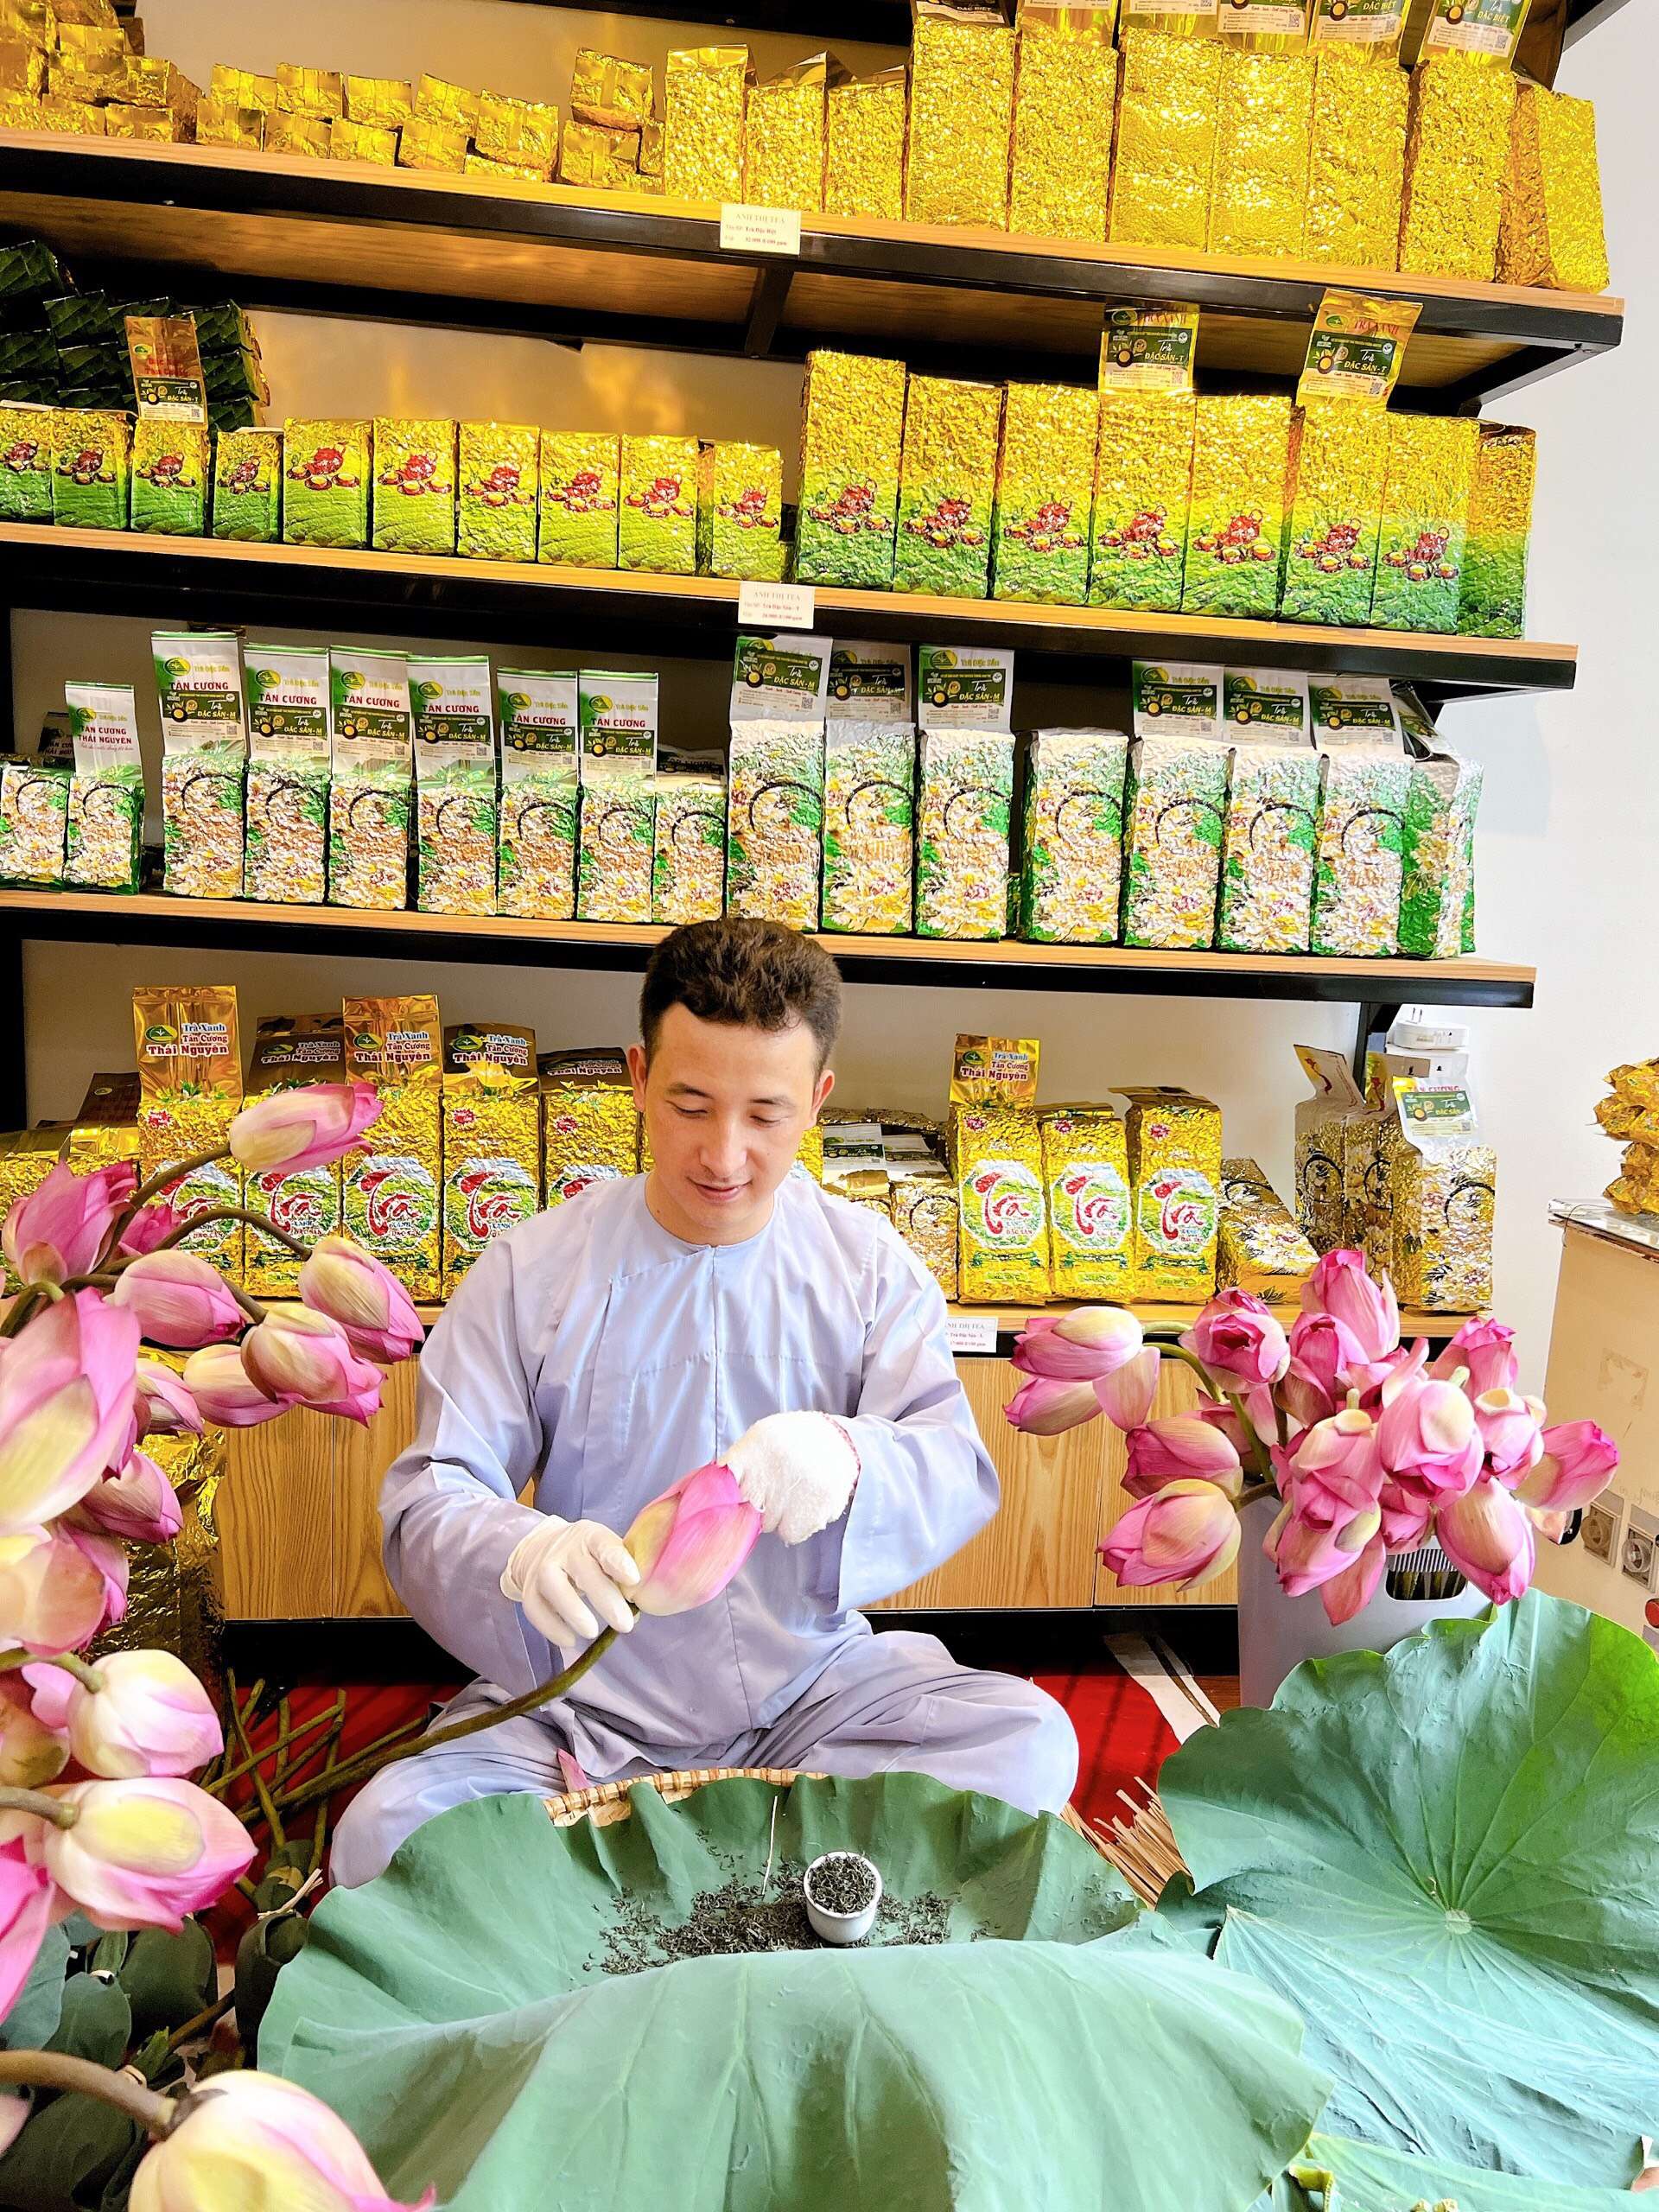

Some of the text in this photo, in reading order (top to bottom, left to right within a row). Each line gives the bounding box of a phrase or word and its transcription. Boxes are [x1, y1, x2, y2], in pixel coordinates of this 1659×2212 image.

[1158, 340, 1175, 352] Trà
[1361, 349, 1376, 362] Trà
[1344, 361, 1359, 371] ĐẶC
[788, 664, 803, 677] Trà
[171, 681, 229, 690] TÂN CƯƠNG
[972, 680, 987, 692] Trà
[208, 698, 224, 710] Trà
[259, 693, 317, 705] TÂN CƯƠNG
[343, 695, 400, 708] TÂN CƯƠNG
[1183, 695, 1199, 705] Trà
[445, 704, 480, 713] CƯƠNG
[295, 716, 311, 727] Trà
[379, 720, 393, 730] Trà
[532, 716, 566, 725] CƯƠNG
[613, 719, 645, 728] CƯƠNG
[99, 727, 127, 735] CƯƠNG
[460, 723, 475, 733] Trà
[99, 734, 132, 744] NGUYÊN
[546, 734, 562, 743] Trà
[626, 737, 641, 747] Trà
[200, 1035, 227, 1044] Cương
[404, 1032, 428, 1040] Xanh
[148, 1045, 227, 1056] Thái Nguyên
[504, 1046, 528, 1055] Cương
[262, 1055, 290, 1064] Thái
[356, 1052, 430, 1063] Thái Nguyên
[454, 1053, 527, 1065] Thái Nguyên
[961, 1068, 1027, 1081] Thái Nguyên
